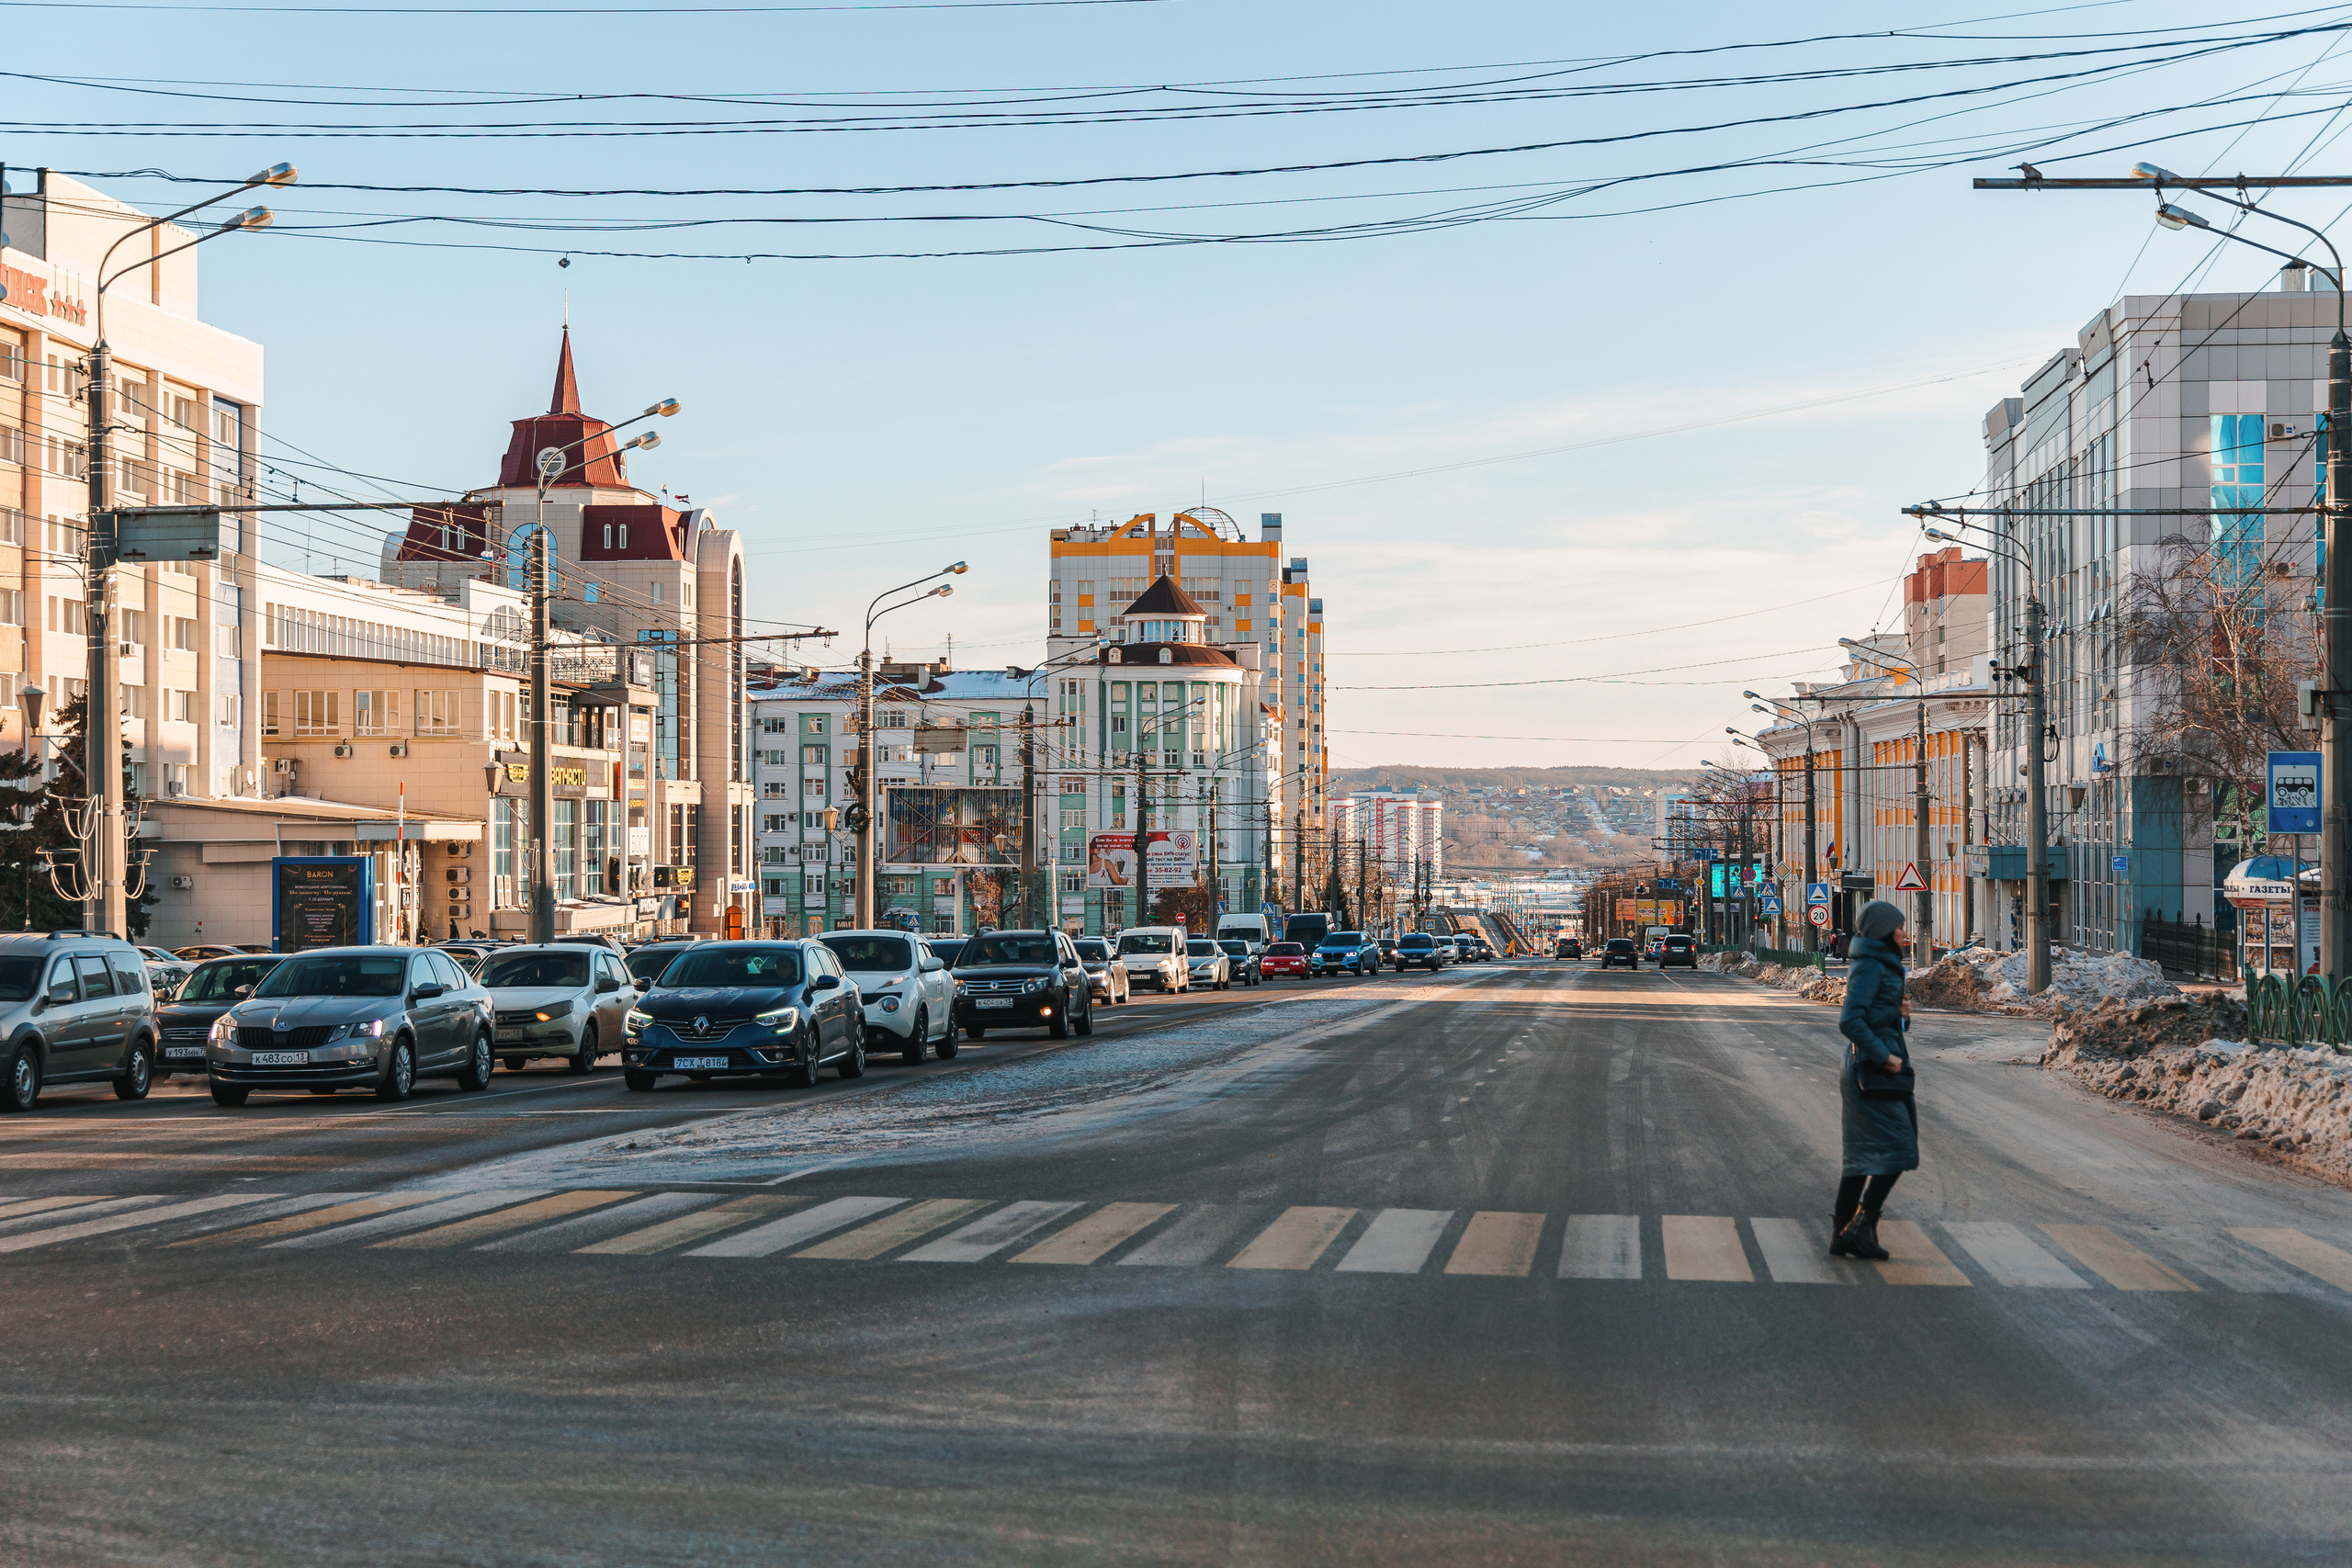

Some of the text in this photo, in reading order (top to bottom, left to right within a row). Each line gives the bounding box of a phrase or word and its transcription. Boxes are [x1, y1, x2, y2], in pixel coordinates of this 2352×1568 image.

[2249, 886, 2291, 894] ГАЗЕТЫ
[1813, 911, 1825, 920] 20
[254, 1053, 305, 1064] К483СО 13
